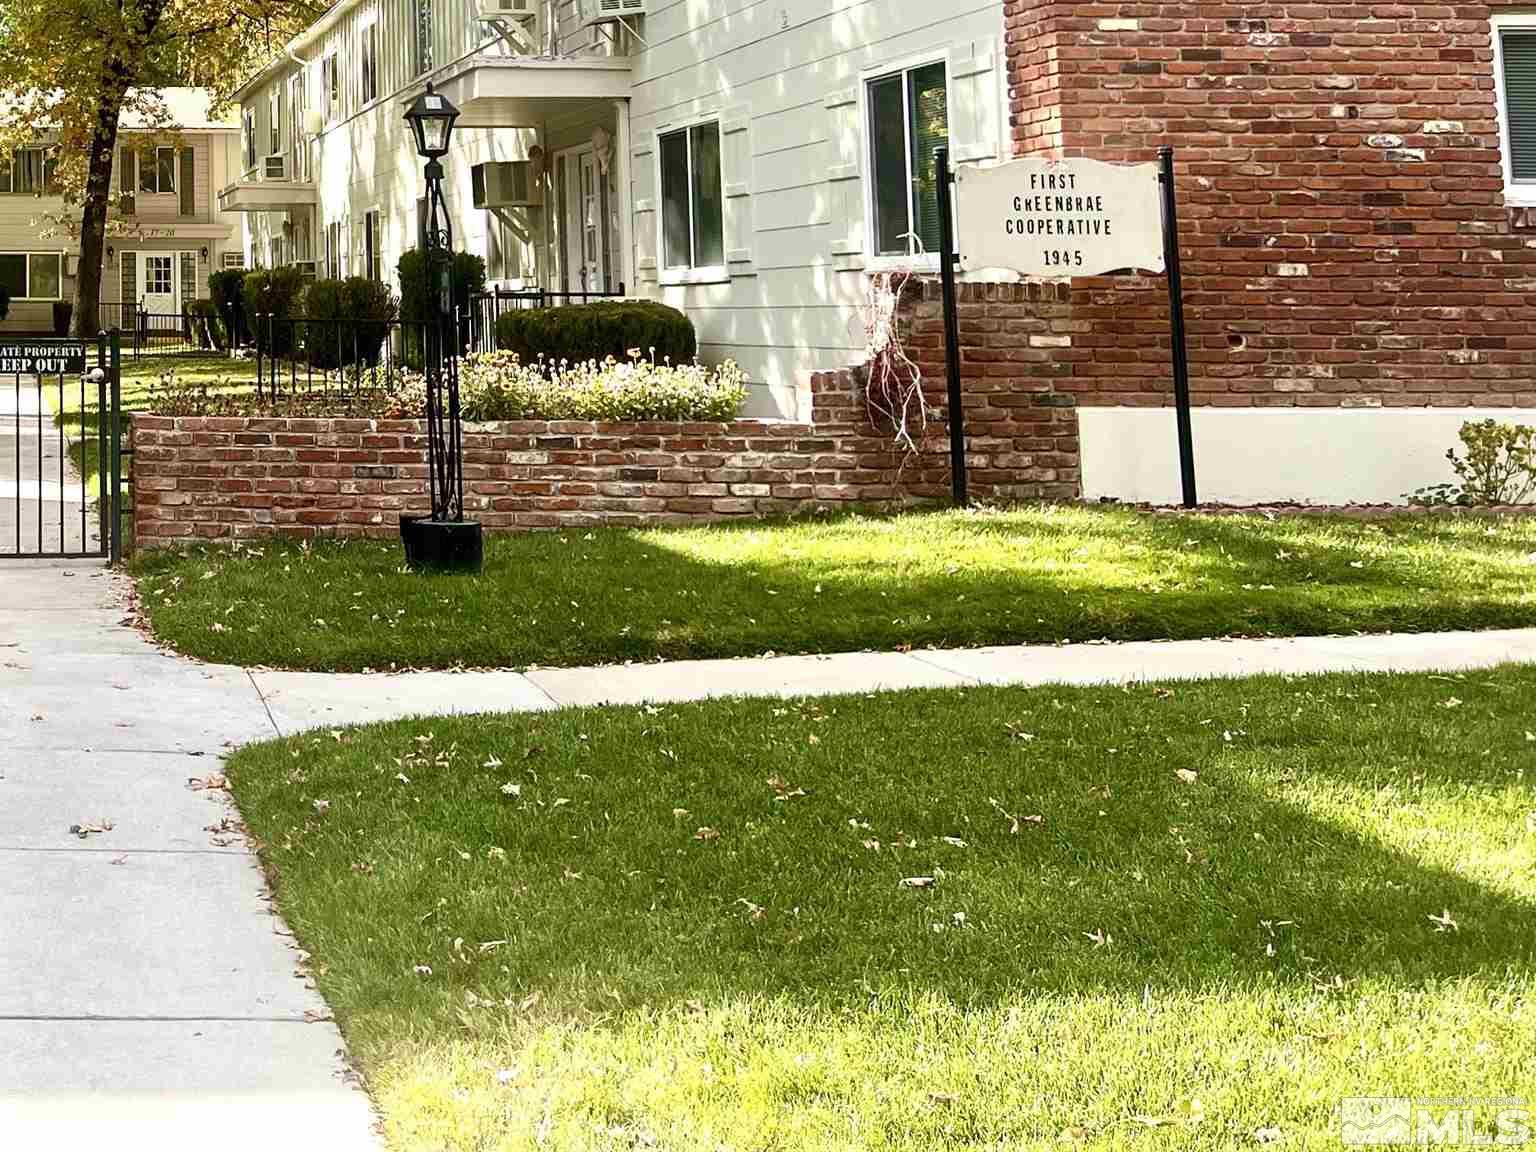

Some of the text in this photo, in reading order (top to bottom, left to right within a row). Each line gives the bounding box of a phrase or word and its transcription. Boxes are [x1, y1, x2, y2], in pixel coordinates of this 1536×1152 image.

[1030, 173, 1076, 190] FIRST
[1013, 195, 1104, 212] GREENBRAE
[1006, 218, 1112, 235] COOPERATIVE
[1043, 250, 1083, 266] 1945
[24, 346, 83, 357] PROPERTY
[35, 358, 68, 372] OUT
